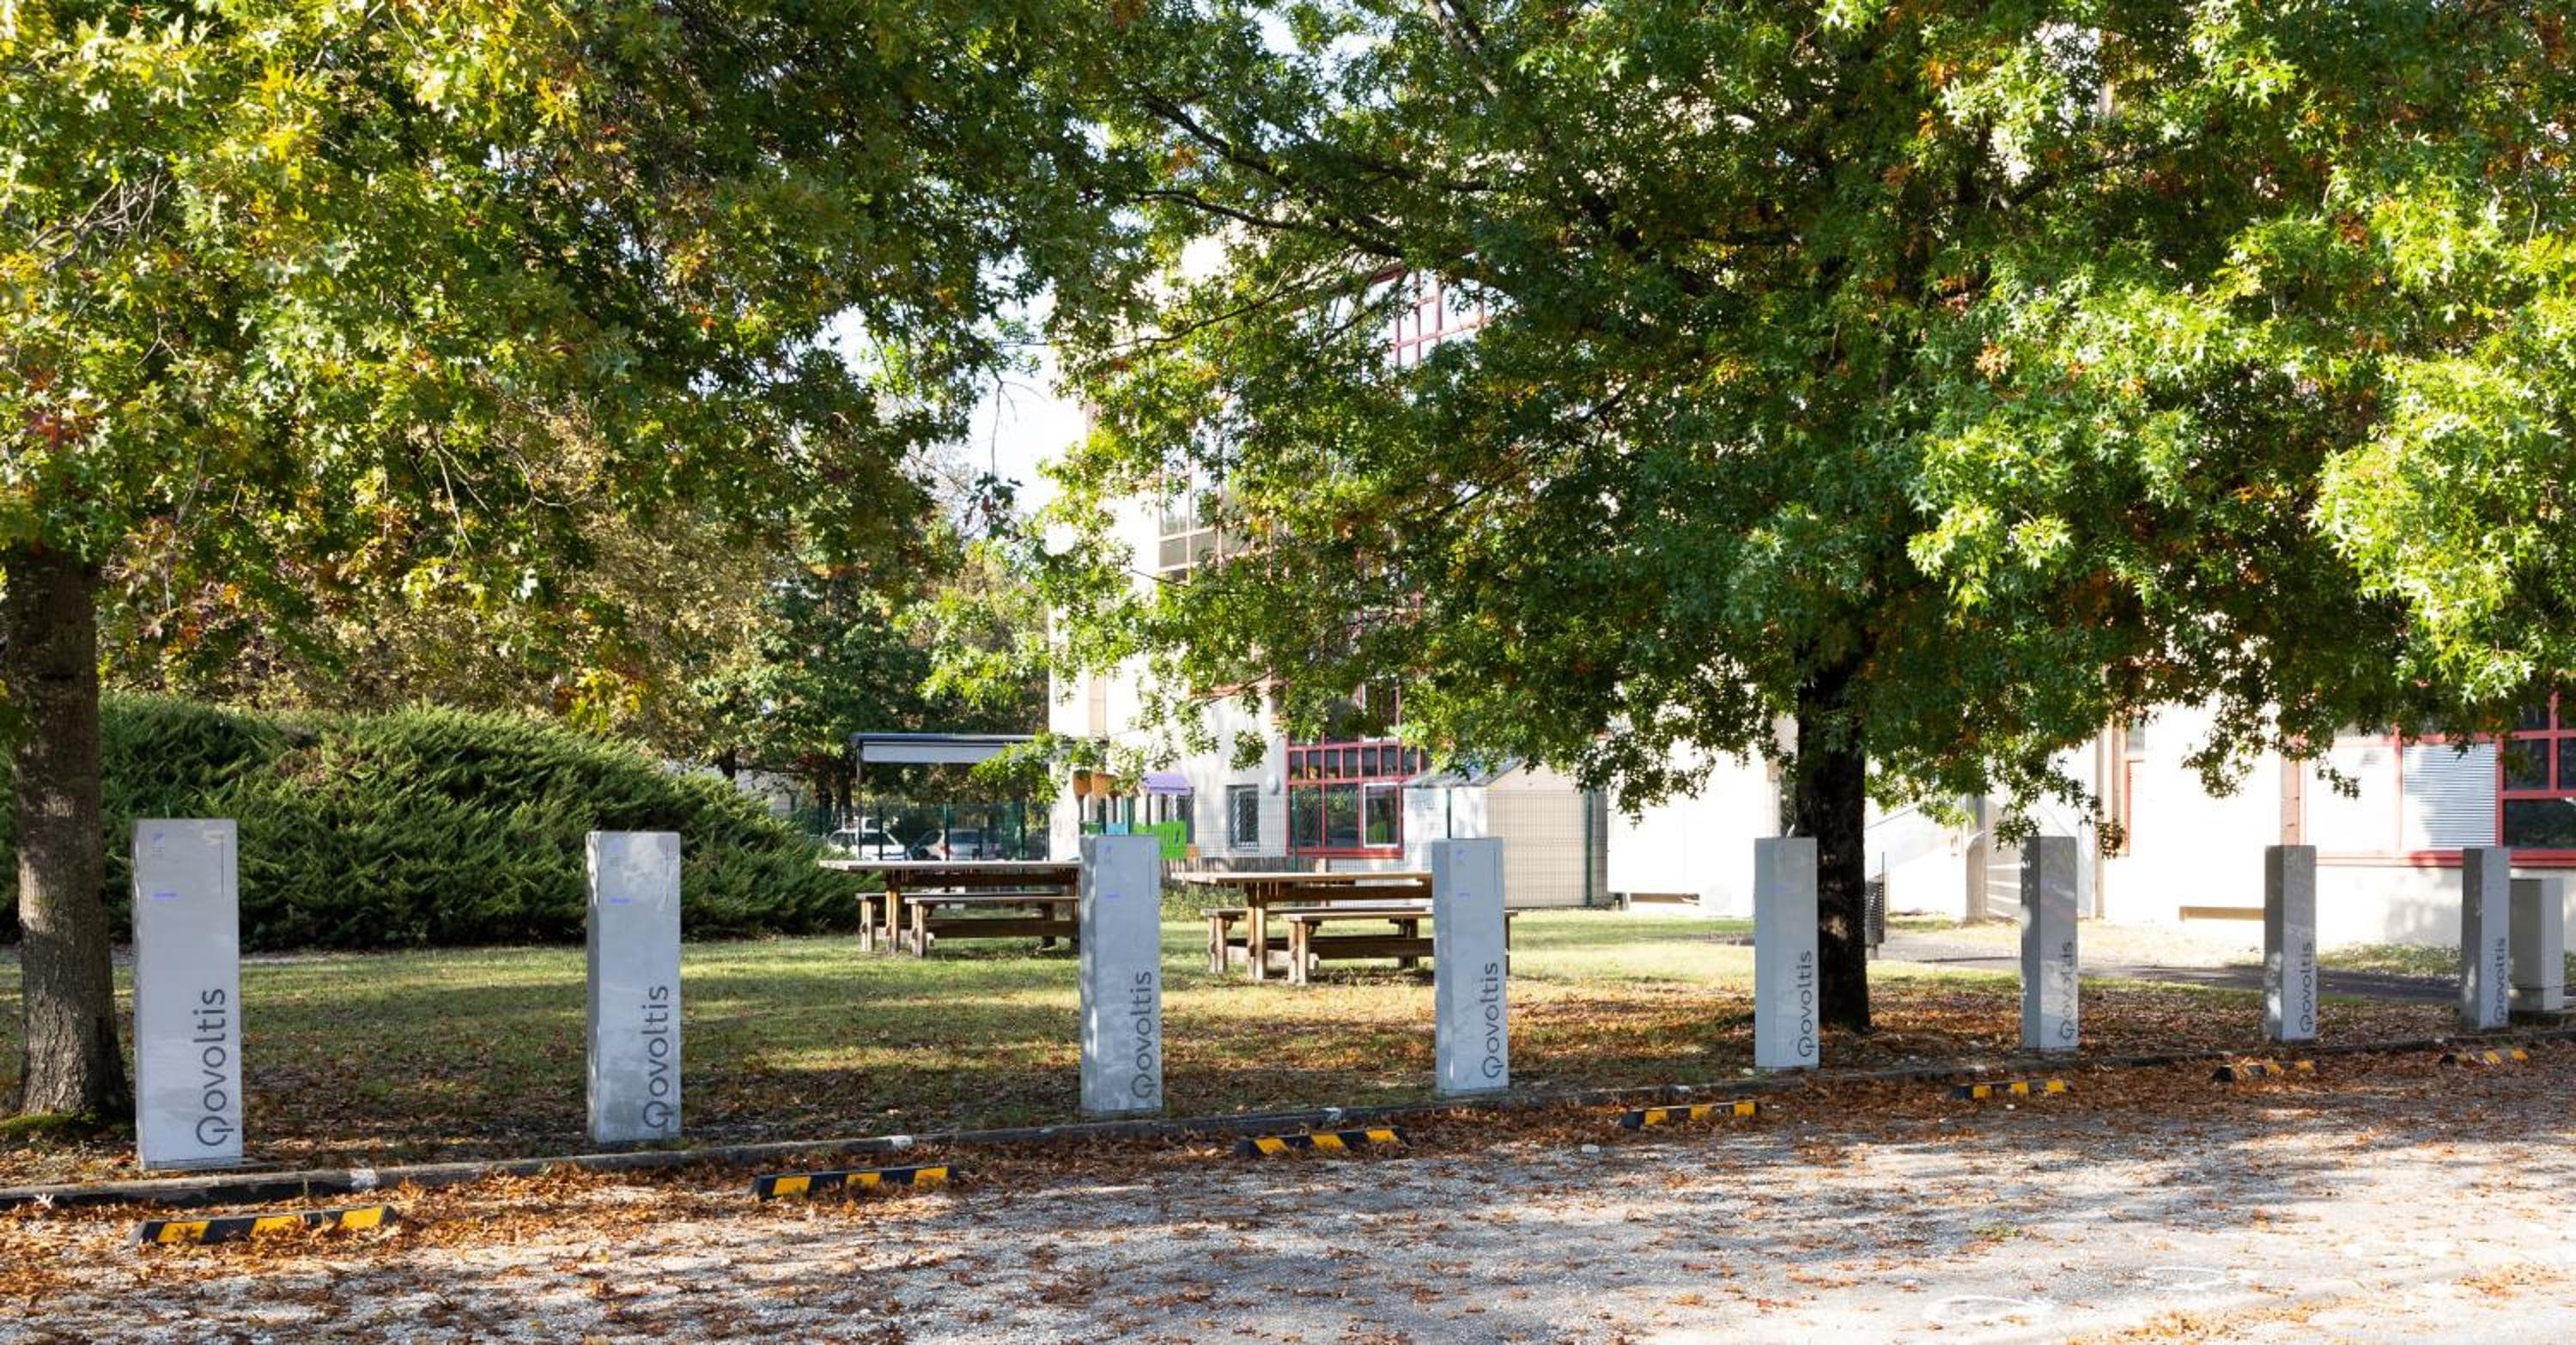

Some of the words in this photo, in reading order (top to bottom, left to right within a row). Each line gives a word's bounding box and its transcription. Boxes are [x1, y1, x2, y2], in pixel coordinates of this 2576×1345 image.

[1130, 971, 1157, 1099] Qovoltis
[1481, 962, 1503, 1079] Qovoltis
[1797, 950, 1814, 1058] Qovoltis
[2299, 941, 2314, 1033] Qovoltis
[193, 988, 234, 1146] Qovoltis
[641, 984, 673, 1129] Qovoltis
